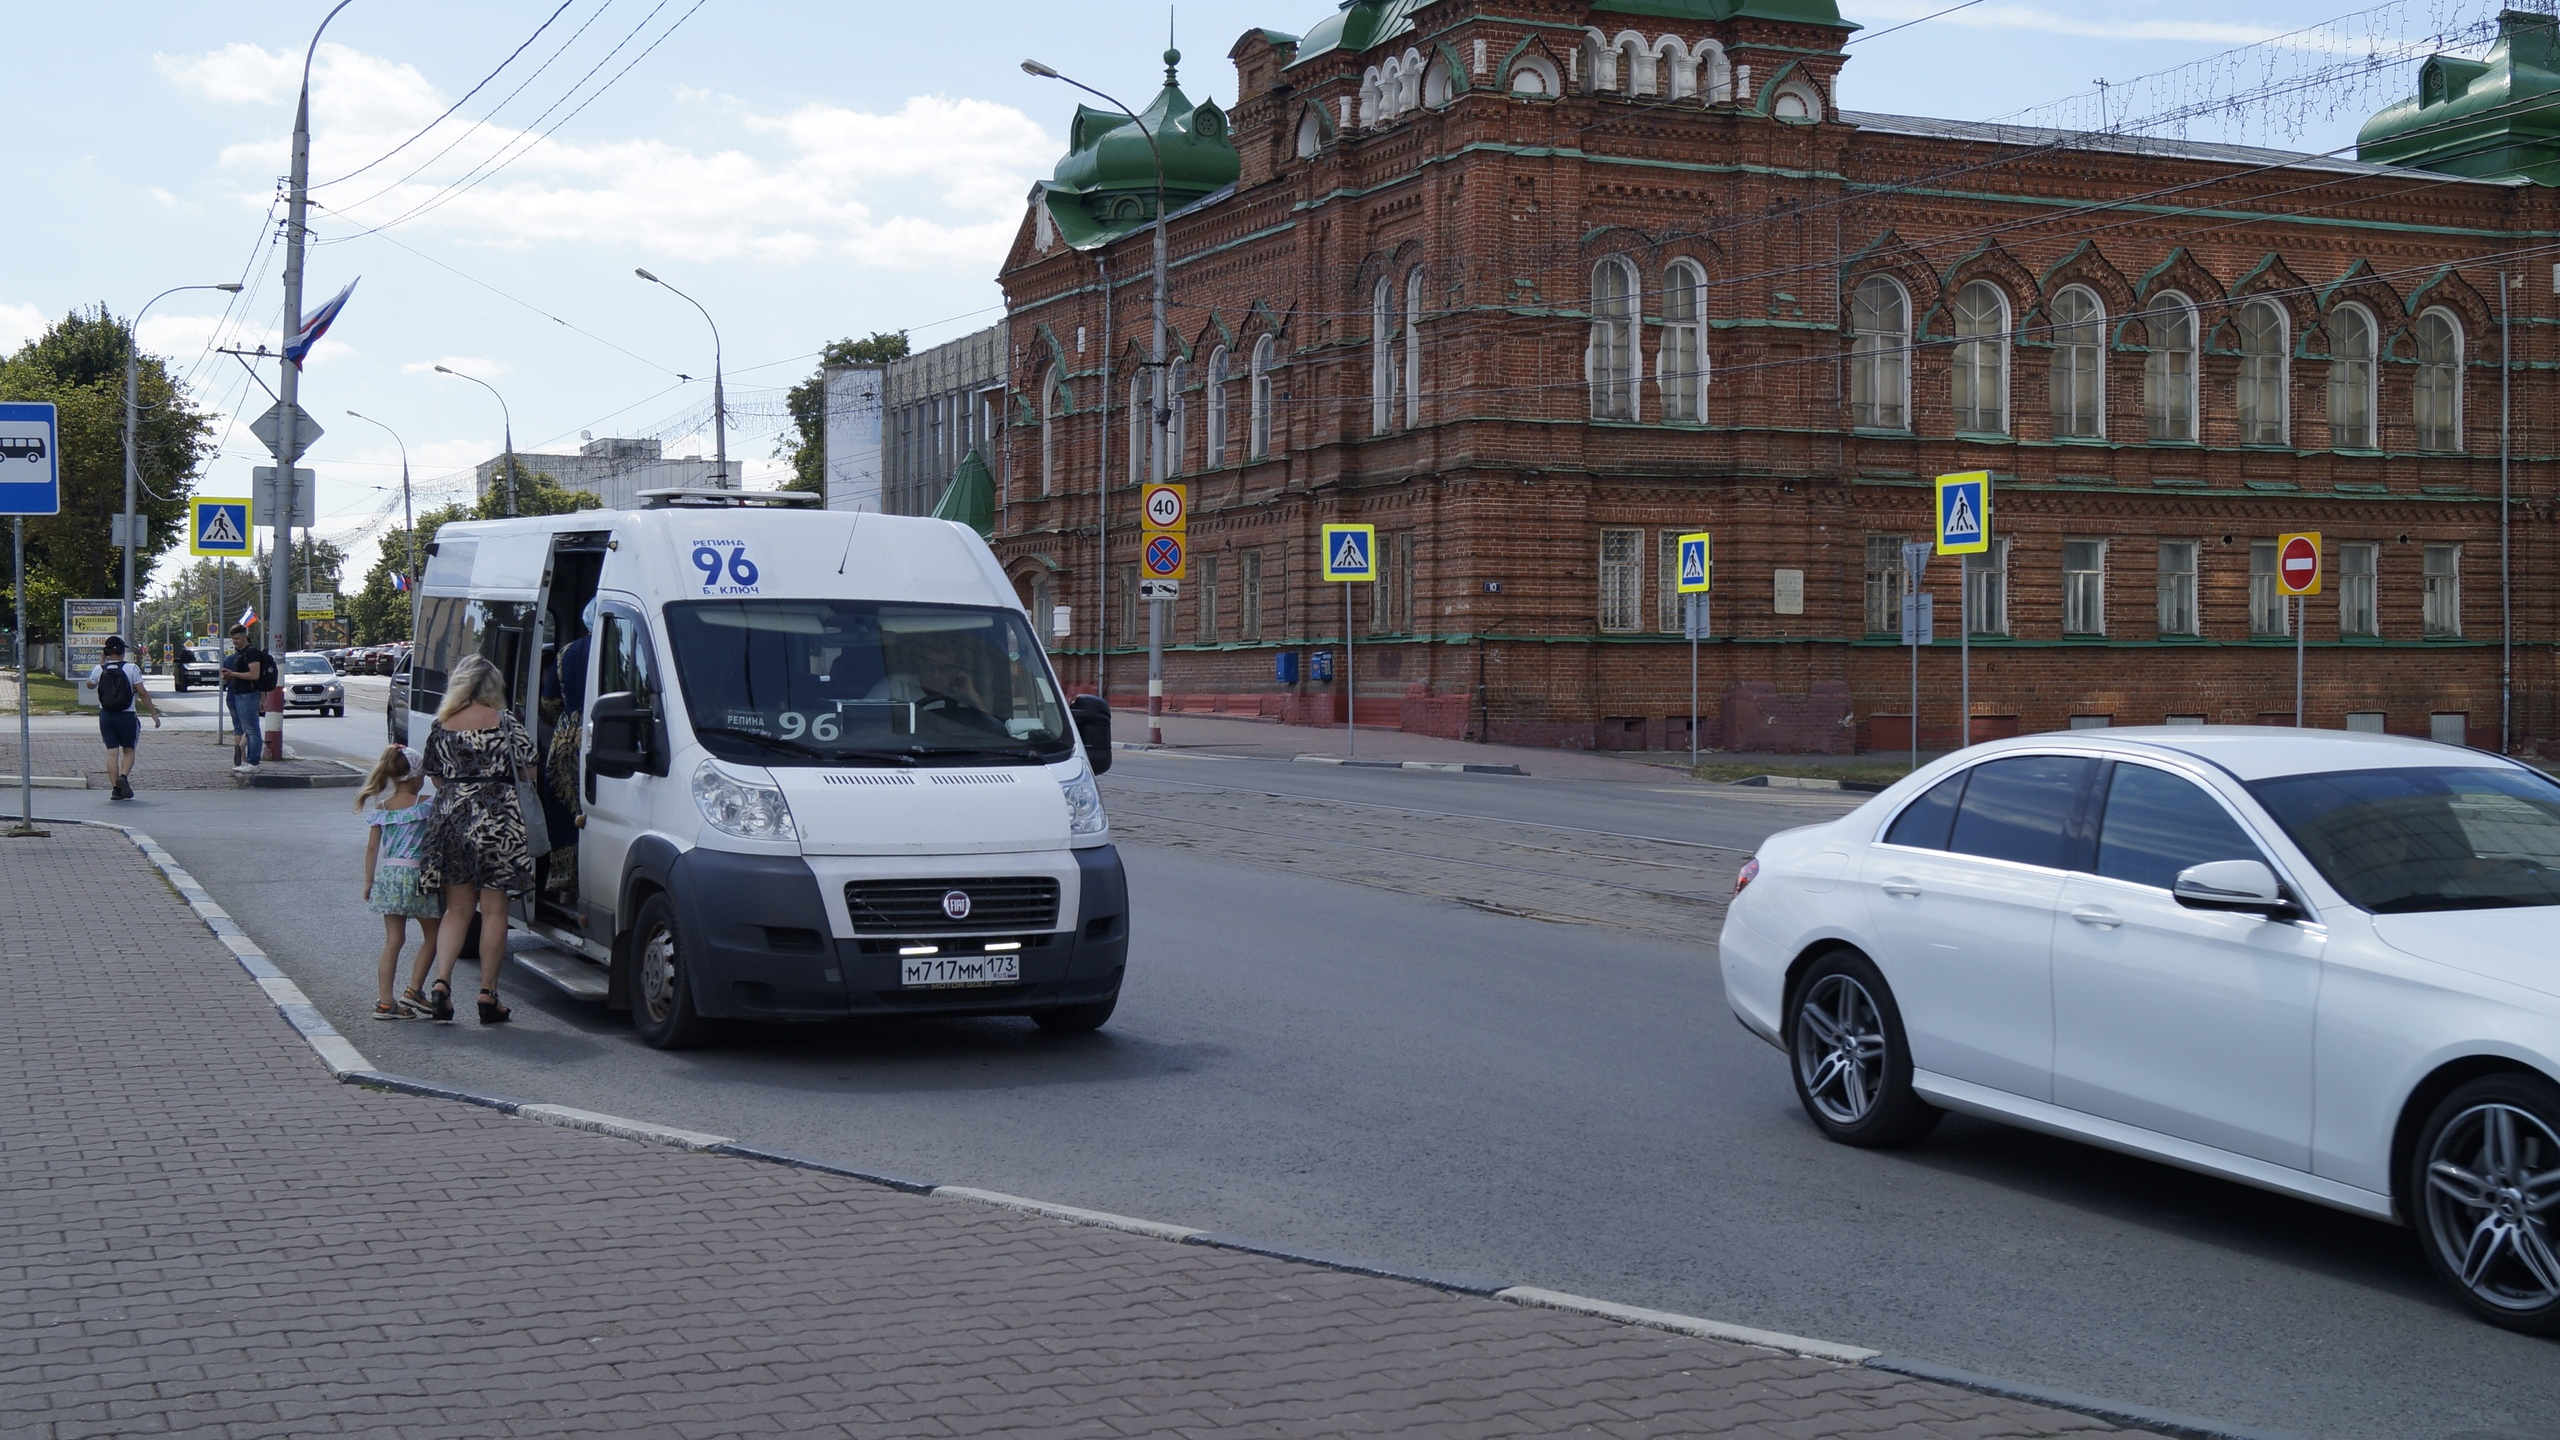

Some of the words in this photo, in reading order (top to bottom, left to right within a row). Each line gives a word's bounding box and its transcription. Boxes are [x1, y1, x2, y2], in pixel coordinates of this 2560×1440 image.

[1153, 499, 1174, 516] 40
[692, 539, 746, 547] РЕПИНА
[691, 546, 759, 587] 96
[702, 586, 715, 595] Б.
[719, 586, 760, 595] КЛЮЧ
[1489, 582, 1497, 592] 10
[68, 637, 89, 645] 12-15
[90, 637, 106, 645] ЯНВ
[727, 715, 765, 727] РЕПИНА
[779, 711, 839, 742] 96
[950, 899, 966, 912] FIAT
[987, 957, 1014, 972] 173
[931, 982, 965, 990] MOTOR
